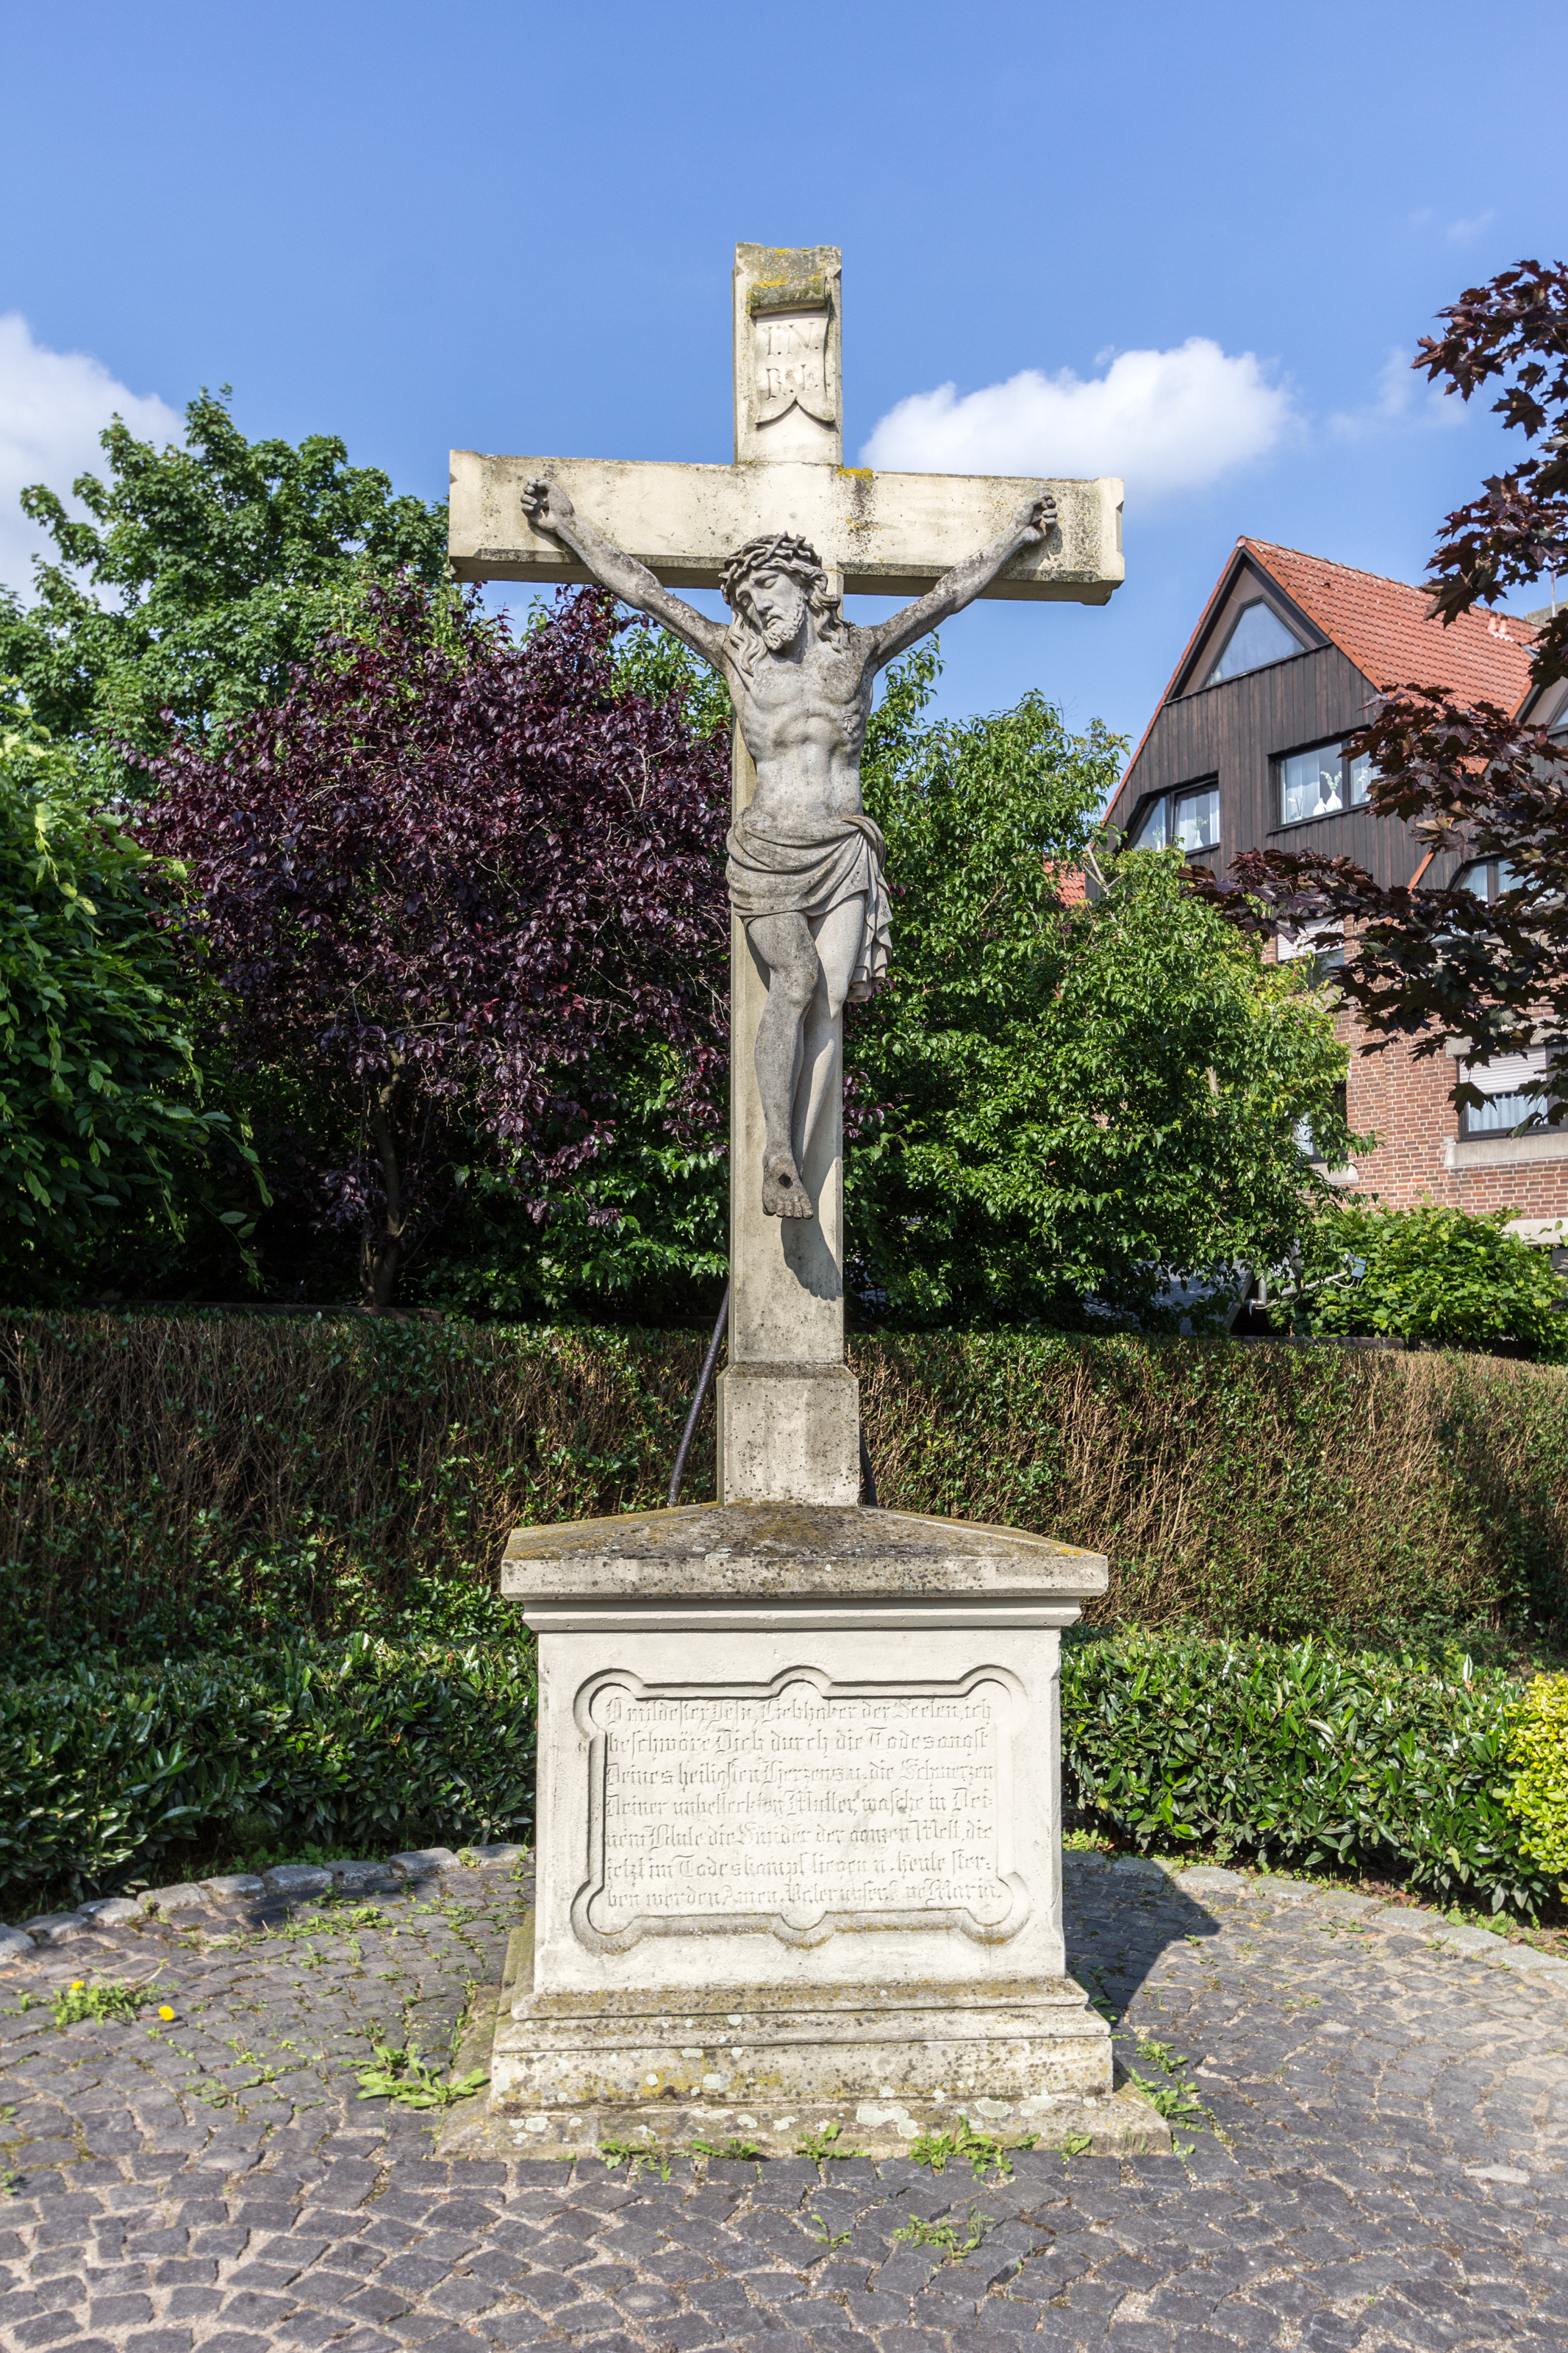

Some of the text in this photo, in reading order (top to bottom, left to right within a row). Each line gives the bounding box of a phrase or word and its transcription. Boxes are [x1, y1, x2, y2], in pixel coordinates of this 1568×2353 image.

[862, 1701, 890, 1719] der
[965, 1699, 992, 1724] ich
[712, 1729, 765, 1759] Dich
[771, 1729, 828, 1758] durch
[837, 1729, 863, 1752] die
[870, 1760, 894, 1780] die
[899, 1758, 993, 1787] Schmerzen
[606, 1793, 671, 1817] Deiner
[929, 1789, 946, 1811] in
[707, 1824, 735, 1847] die
[735, 1822, 812, 1846] Sünder
[817, 1824, 845, 1843] der
[966, 1819, 992, 1839] die
[648, 1857, 673, 1879] im
[812, 1852, 867, 1878] liegen
[898, 1850, 945, 1879] heute
[608, 1889, 642, 1908] ben
